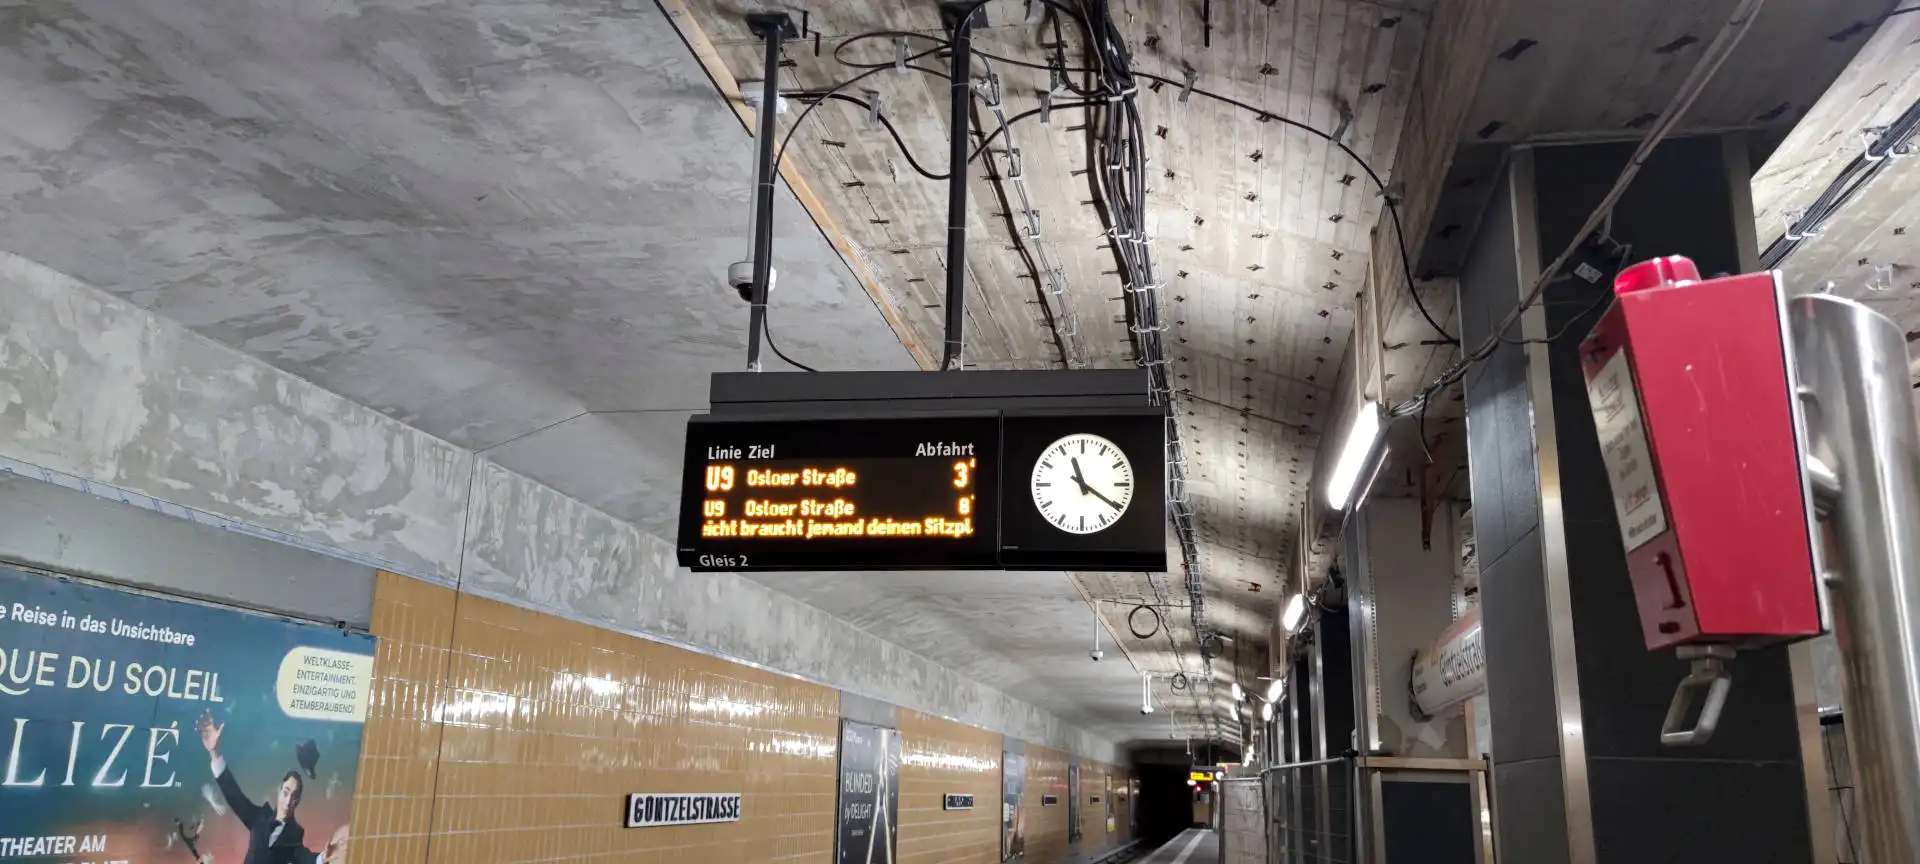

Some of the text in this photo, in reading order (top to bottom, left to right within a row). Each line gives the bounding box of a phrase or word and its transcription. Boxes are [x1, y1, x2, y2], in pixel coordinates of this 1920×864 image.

[707, 441, 975, 460] Linie Ziel Abfahrt
[705, 464, 734, 491] U9
[747, 468, 798, 486] Osloer
[801, 467, 856, 488] Straße
[703, 500, 725, 517] U9
[744, 499, 797, 517] Osloer
[800, 499, 855, 518] Straße
[740, 519, 804, 537] braucht
[806, 518, 864, 539] jemand
[866, 518, 922, 536] deinen
[924, 517, 974, 538] Sitzpl
[699, 554, 749, 567] Gleis 2
[11, 602, 58, 627] Reise
[61, 610, 76, 630] in
[79, 614, 108, 634] das
[111, 618, 196, 646] Unsichtbare
[303, 655, 355, 671] WELTKLASSE-
[66, 655, 116, 692] DU
[123, 662, 224, 703] SOLEIL
[292, 683, 357, 700] EINZIGARTIG UND
[845, 771, 874, 794] BLINDED
[851, 803, 873, 820] DELIGHT
[0, 834, 107, 857] THEATER AM
